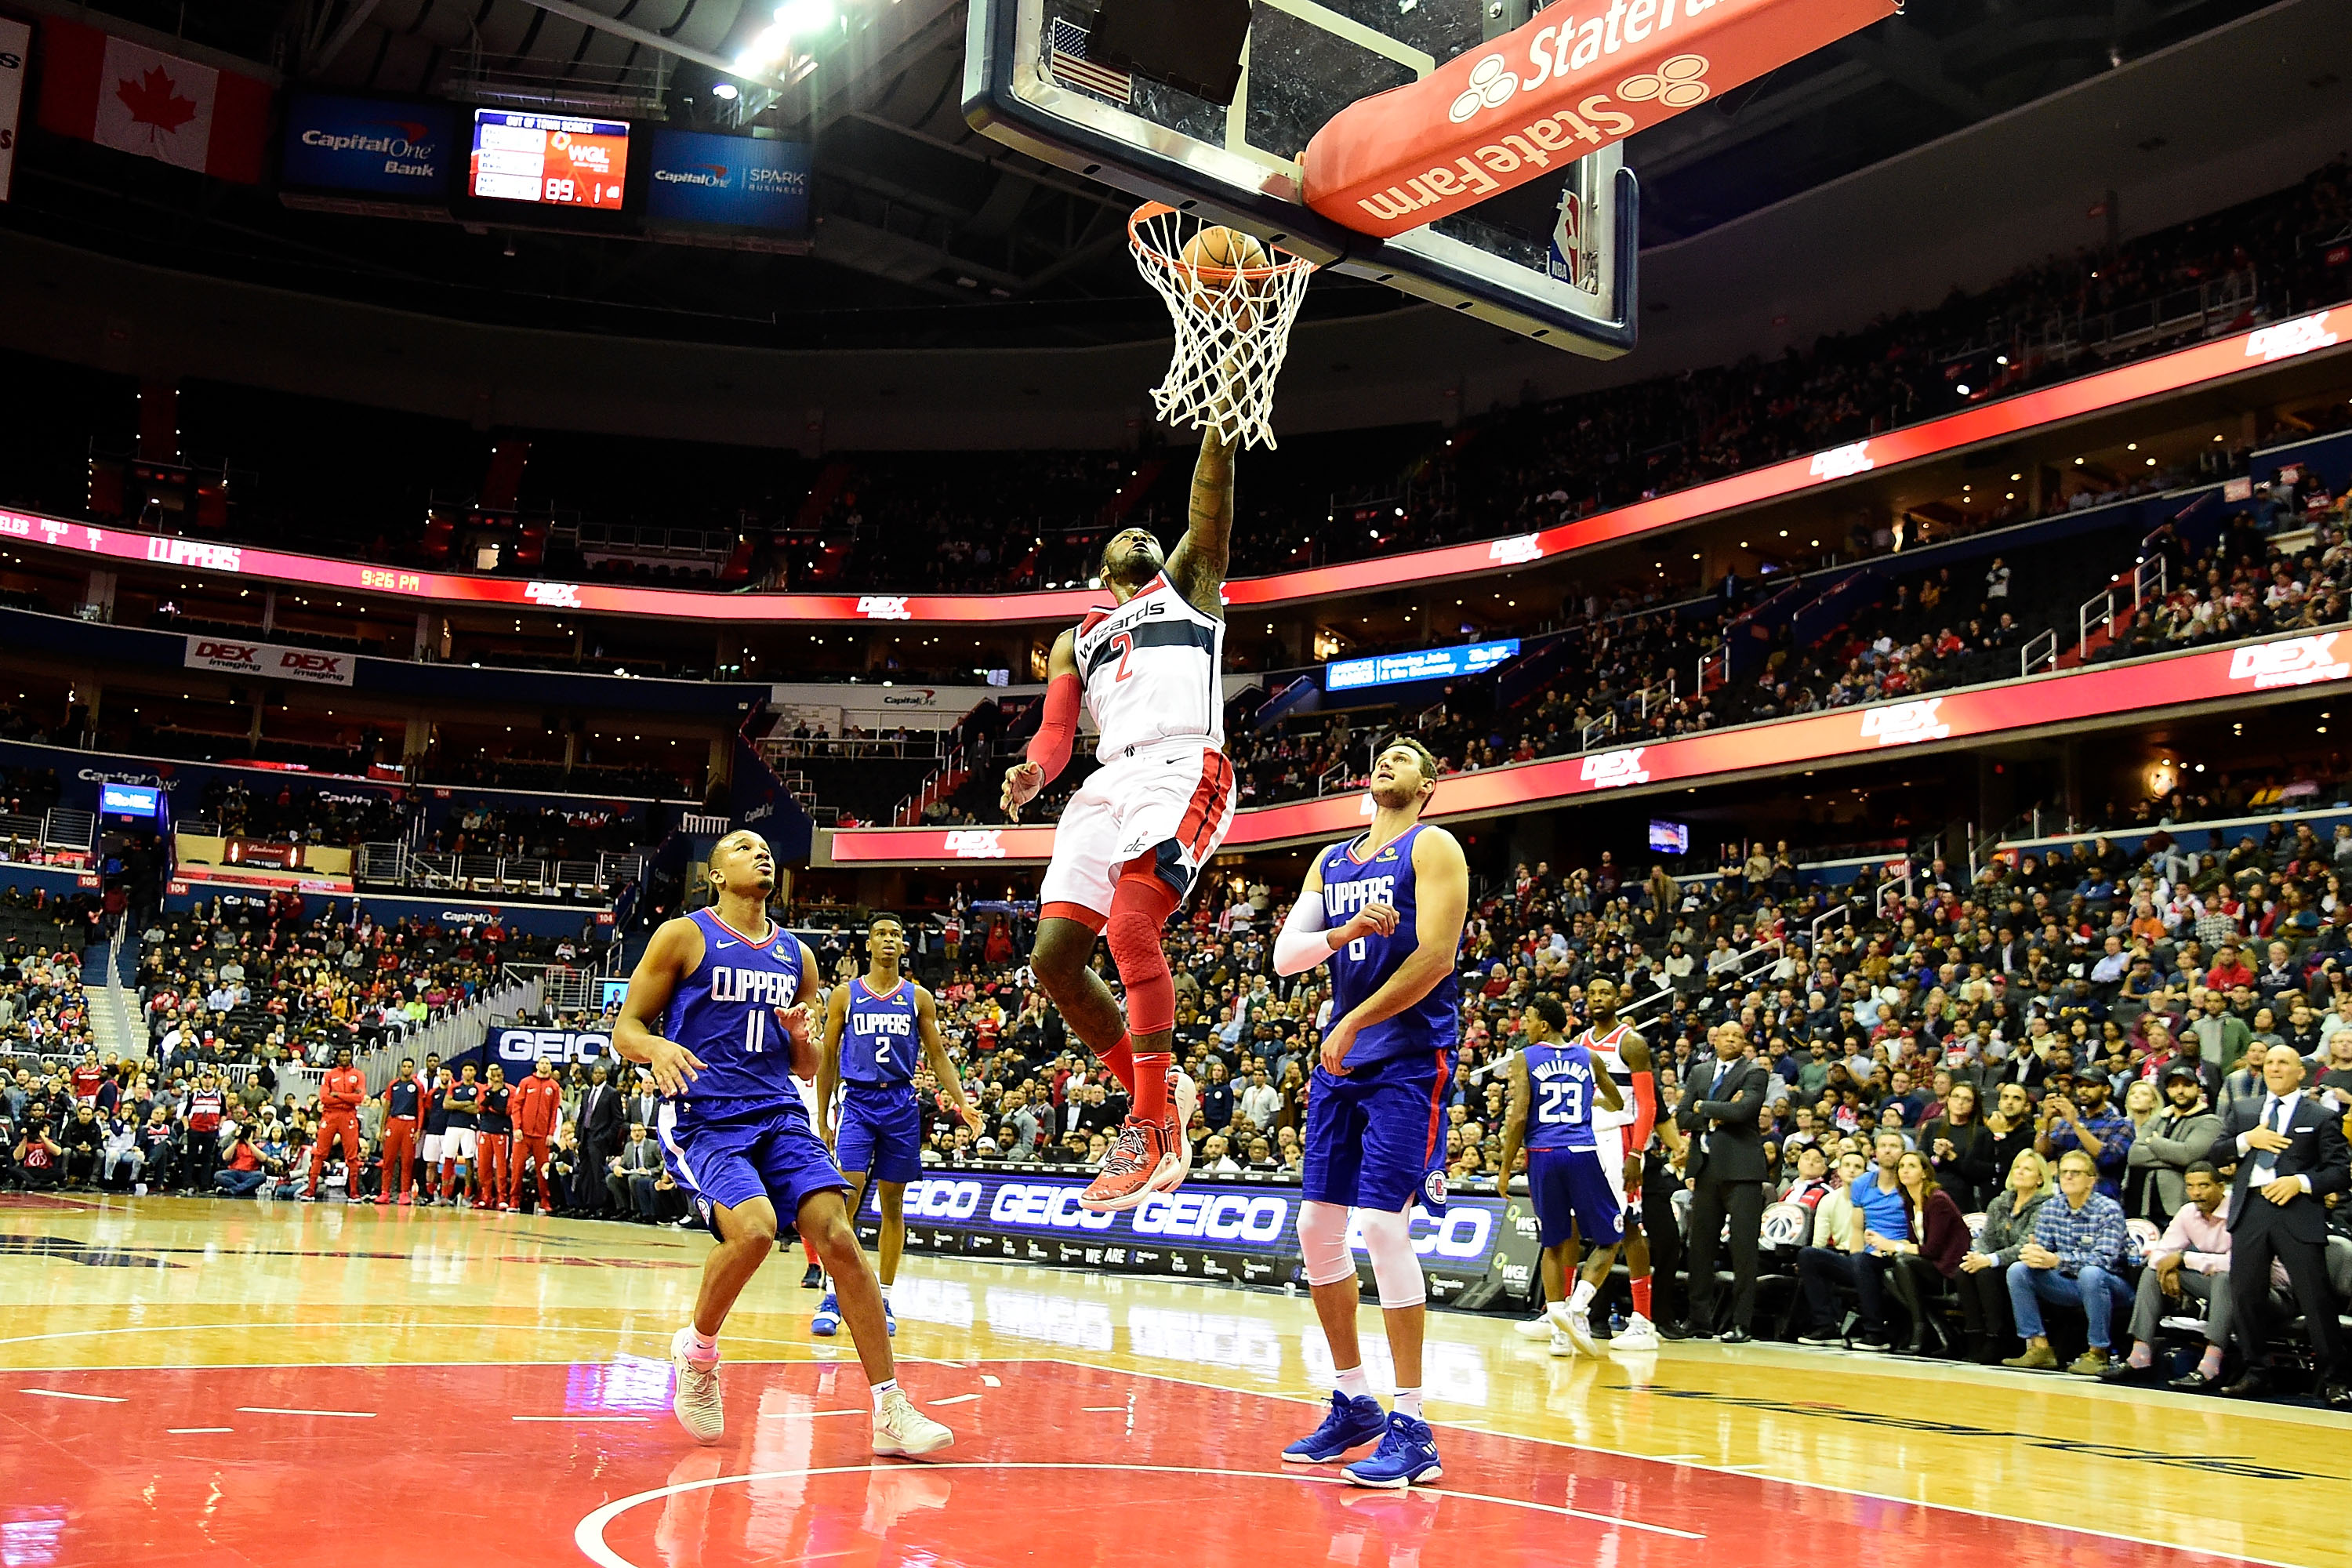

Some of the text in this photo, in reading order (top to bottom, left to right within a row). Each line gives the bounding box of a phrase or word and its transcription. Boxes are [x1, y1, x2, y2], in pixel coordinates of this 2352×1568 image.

[568, 144, 610, 164] WGL
[384, 161, 434, 177] Bank
[750, 169, 804, 185] SPARK
[749, 183, 804, 195] BUSINESS
[1552, 260, 1567, 280] NBA
[2245, 311, 2330, 356] DEX
[1809, 440, 1869, 475] DEX
[147, 537, 241, 572] CLIPPERS
[1490, 533, 1540, 559] DEX
[361, 569, 419, 591] 9:26 PM
[524, 582, 579, 600] DEX
[856, 597, 909, 612] DEX
[1079, 601, 1166, 660] wizards
[195, 642, 341, 673] DEX DEX
[1110, 631, 1134, 683] 2
[2229, 632, 2339, 679] DEX
[209, 659, 344, 682] imaging imaging
[1860, 698, 1943, 736] DEX
[1581, 747, 1645, 780] DEX
[944, 830, 1003, 850] DEX
[82, 877, 98, 886] 105
[170, 884, 187, 894] 104
[599, 914, 613, 923] 104
[711, 966, 797, 1008] CLIPPERS
[746, 1009, 765, 1053] 11
[853, 1013, 911, 1036] CLIPPERS
[875, 1036, 890, 1062] 2
[1531, 1060, 1590, 1082] WILLIAMS
[1539, 1082, 1582, 1123] 23
[871, 1179, 982, 1219] EICO
[1132, 1191, 1288, 1243] GEICO
[1516, 1217, 1537, 1232] WG
[1085, 1248, 1102, 1264] WE
[1104, 1247, 1126, 1264] ARE
[1502, 1264, 1529, 1280] WGL
